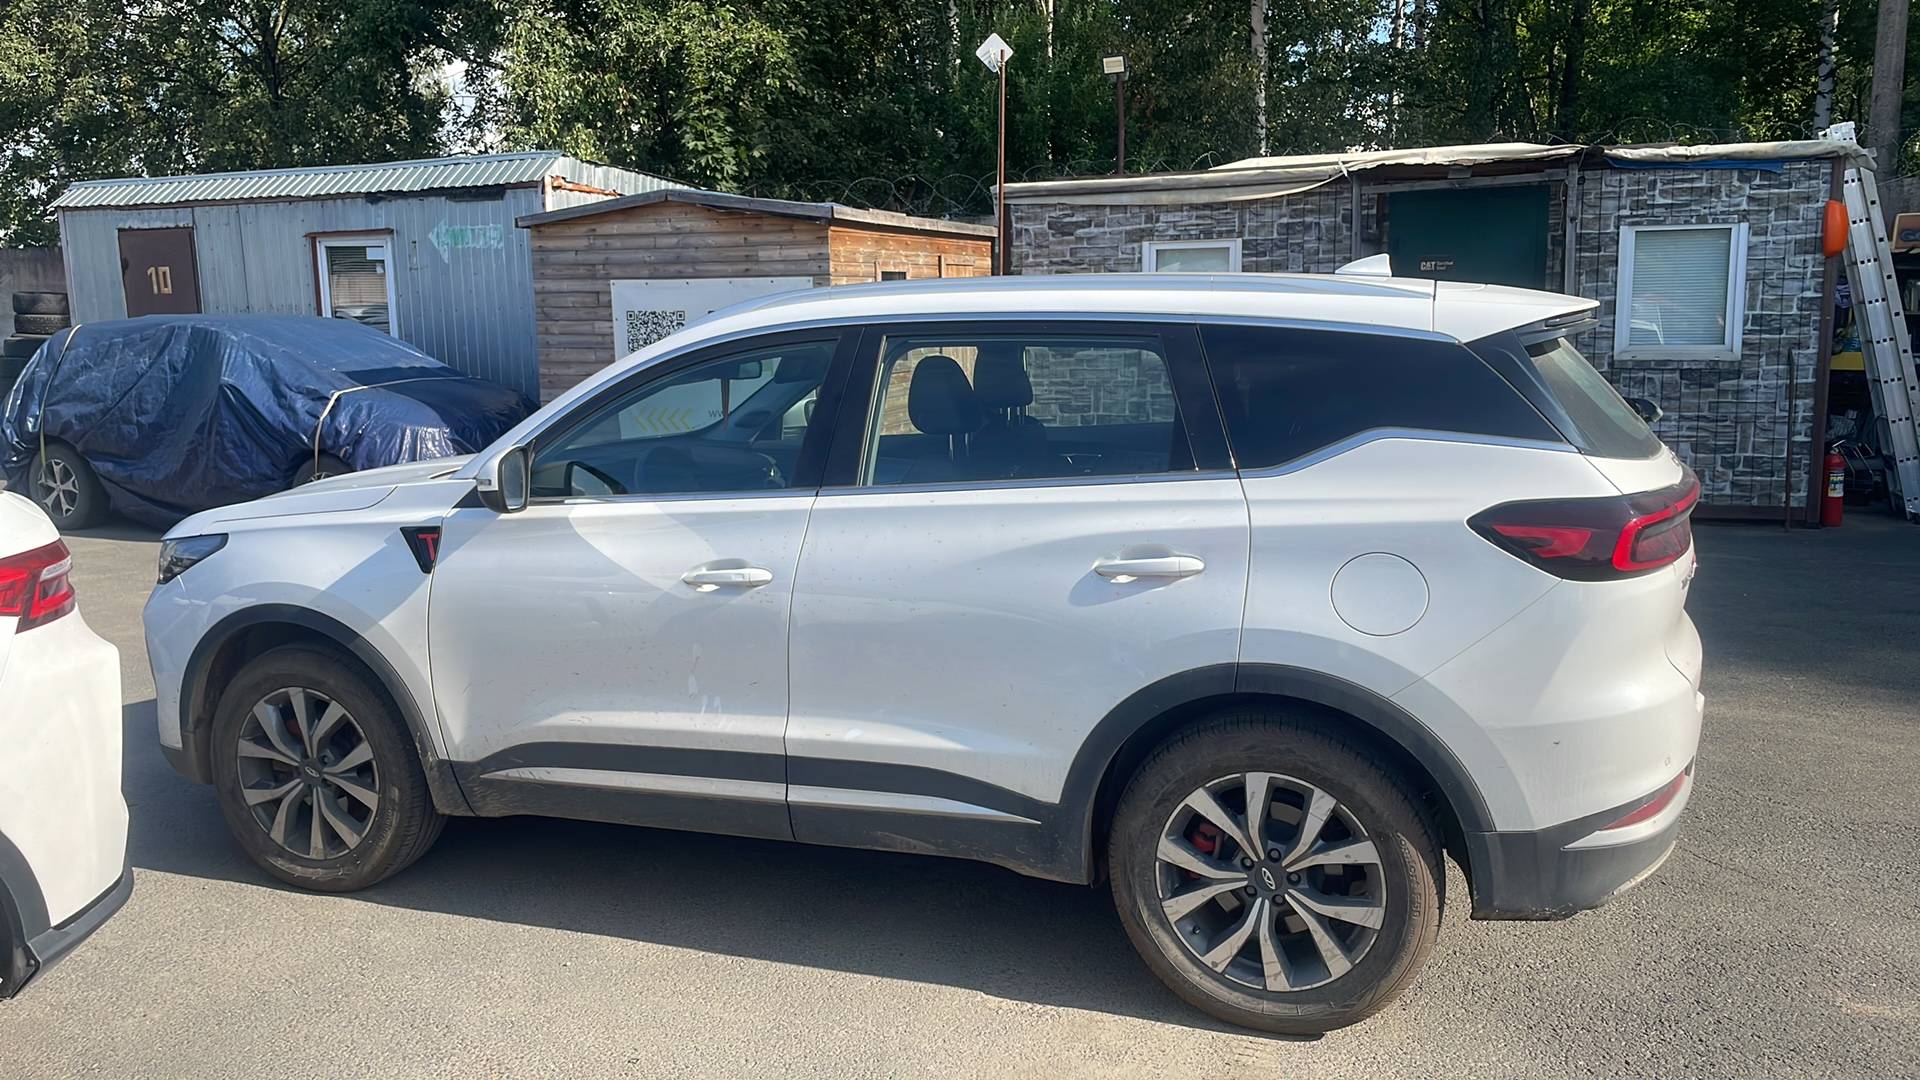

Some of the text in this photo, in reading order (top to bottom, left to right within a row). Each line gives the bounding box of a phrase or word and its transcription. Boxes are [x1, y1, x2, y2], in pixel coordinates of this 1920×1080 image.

[147, 266, 173, 294] 10
[1420, 261, 1436, 271] CAT
[416, 533, 439, 561] T
